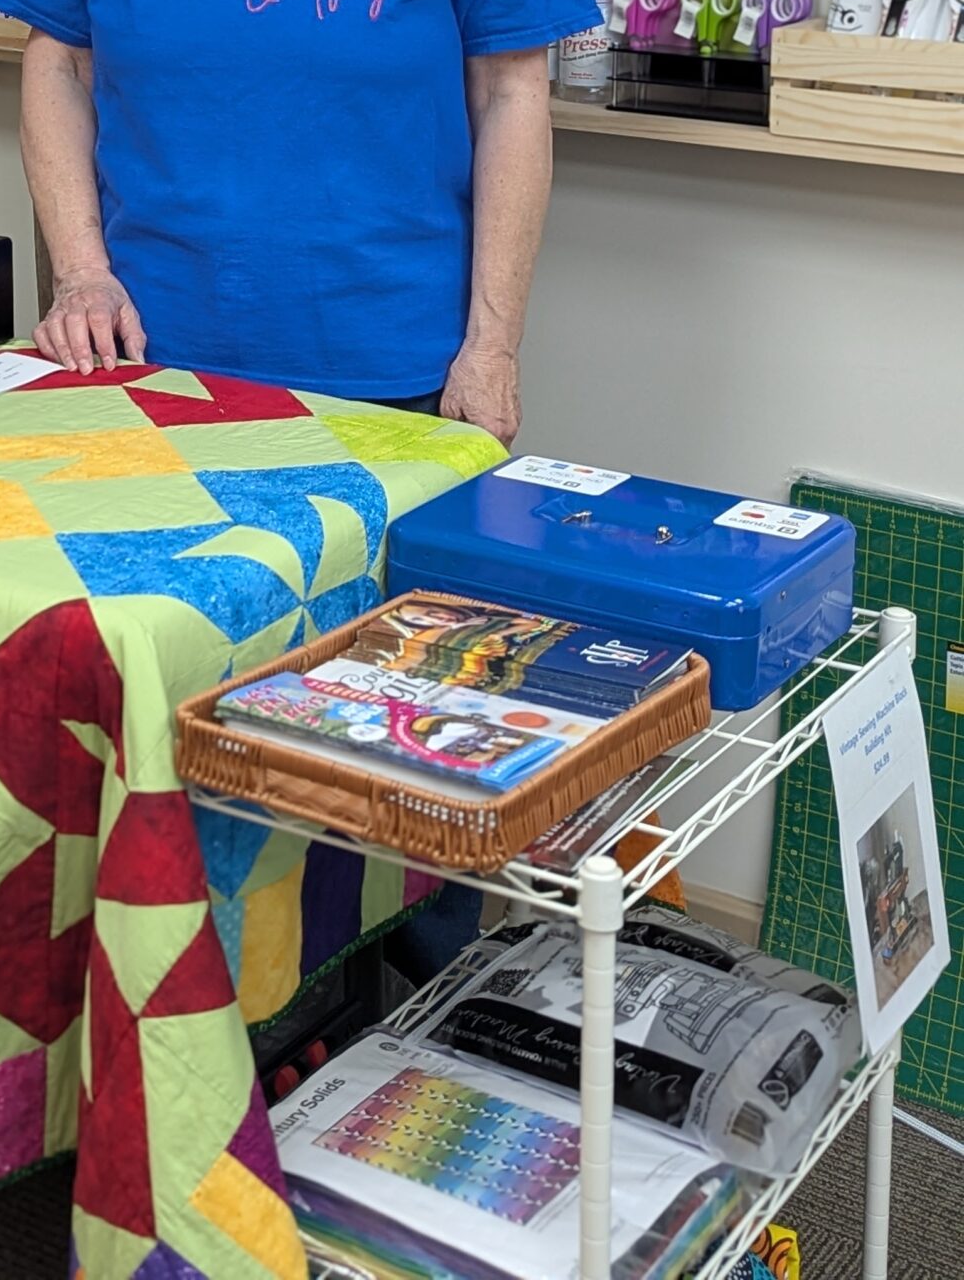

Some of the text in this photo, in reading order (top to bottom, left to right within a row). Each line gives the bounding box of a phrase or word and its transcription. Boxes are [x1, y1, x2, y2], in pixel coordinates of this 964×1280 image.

[563, 38, 607, 56] Press
[839, 686, 907, 756] Vintage Sewing Machine Block
[864, 724, 892, 756] Building Kit
[874, 752, 890, 774] $24.99
[456, 1008, 529, 1045] Machin
[511, 1045, 544, 1064] TOMATO
[615, 1052, 681, 1094] Vintag
[274, 1076, 346, 1138] ntury Solids
